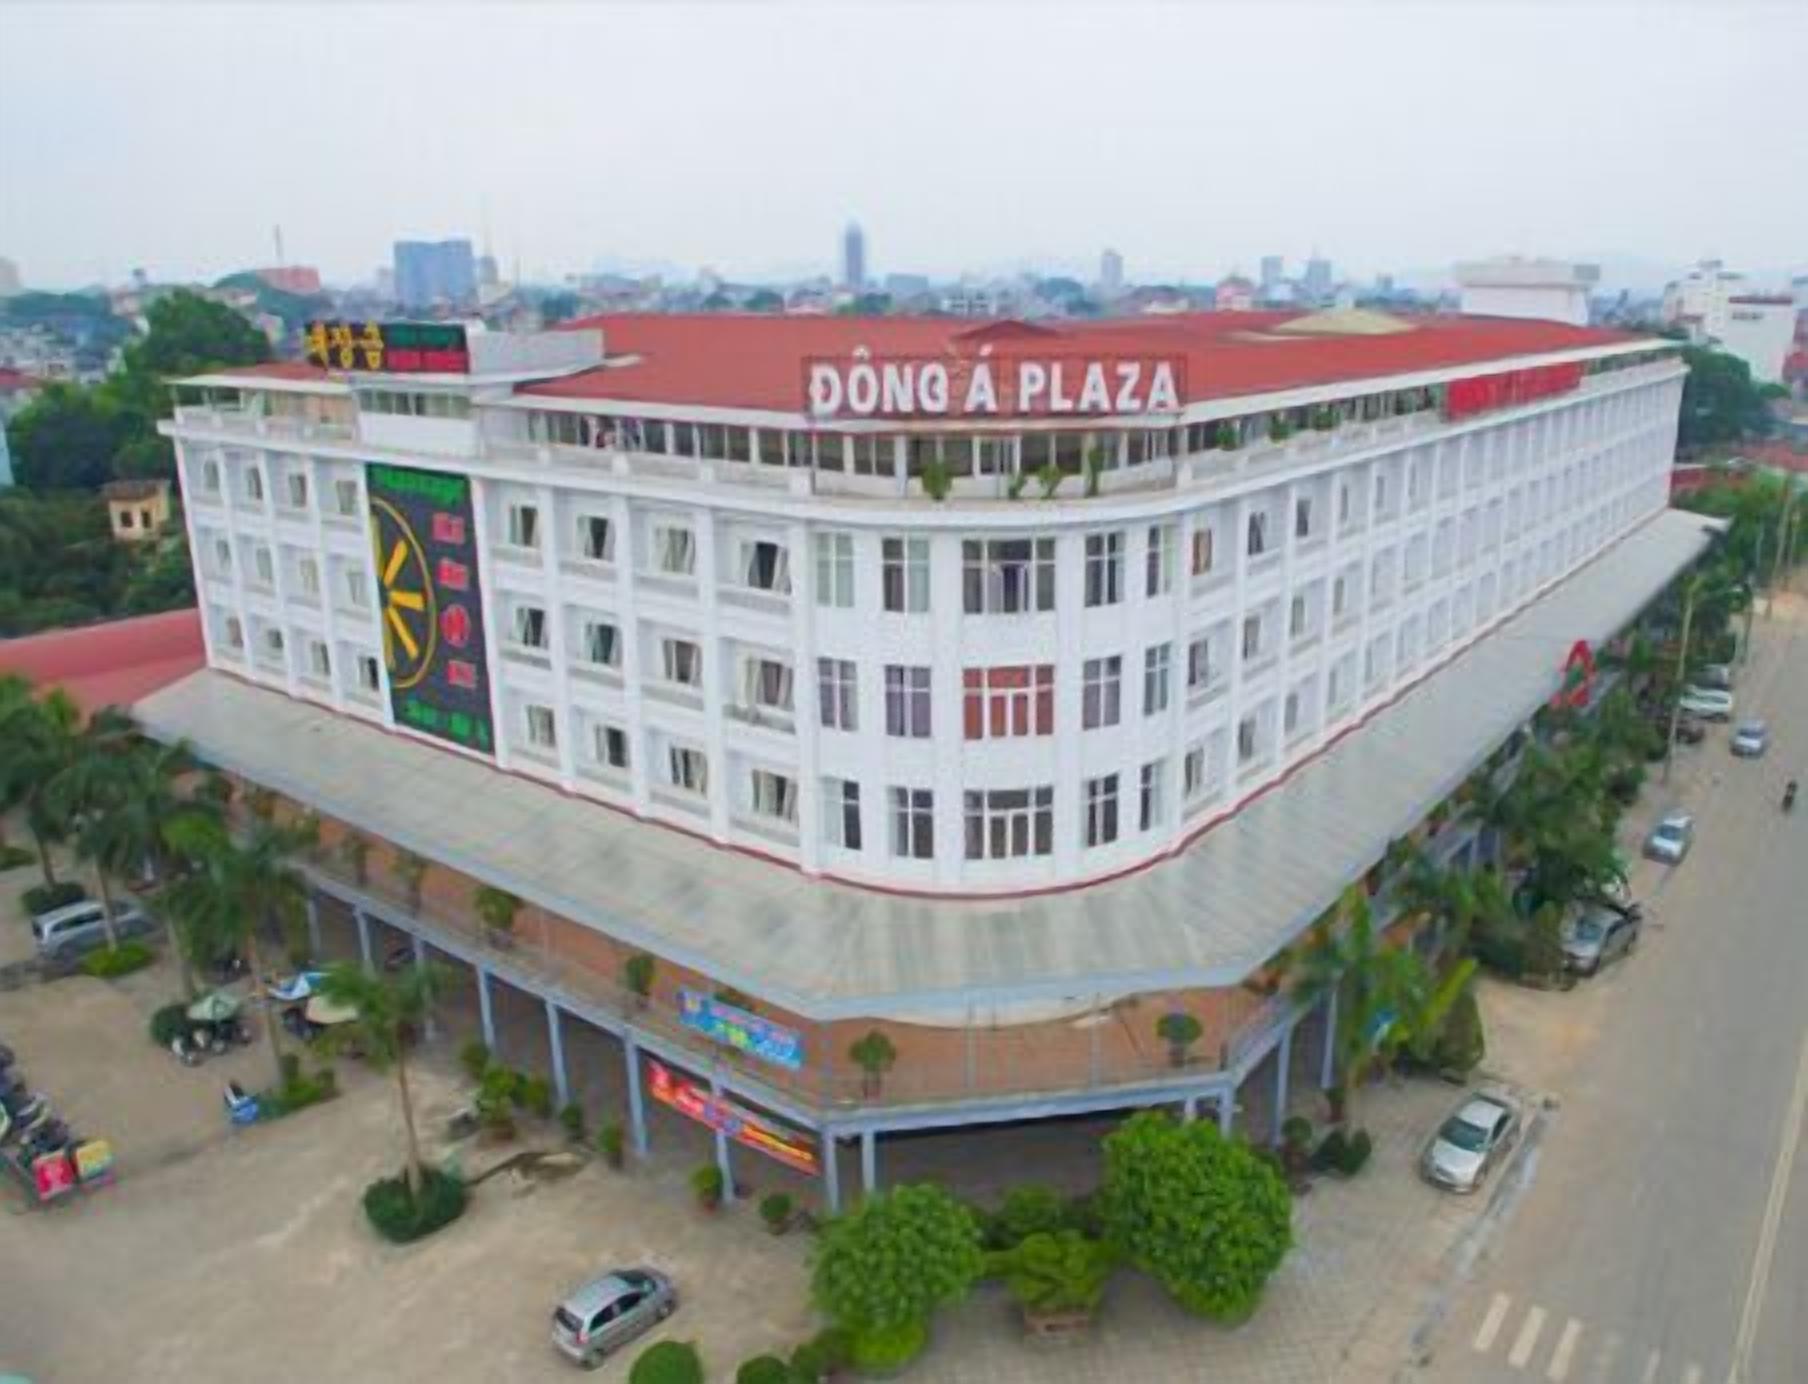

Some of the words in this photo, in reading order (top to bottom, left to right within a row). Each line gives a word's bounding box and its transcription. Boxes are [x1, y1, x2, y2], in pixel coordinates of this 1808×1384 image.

[808, 345, 949, 414] ĐÔNG
[964, 343, 998, 413] Á
[1019, 360, 1183, 413] PLAZA
